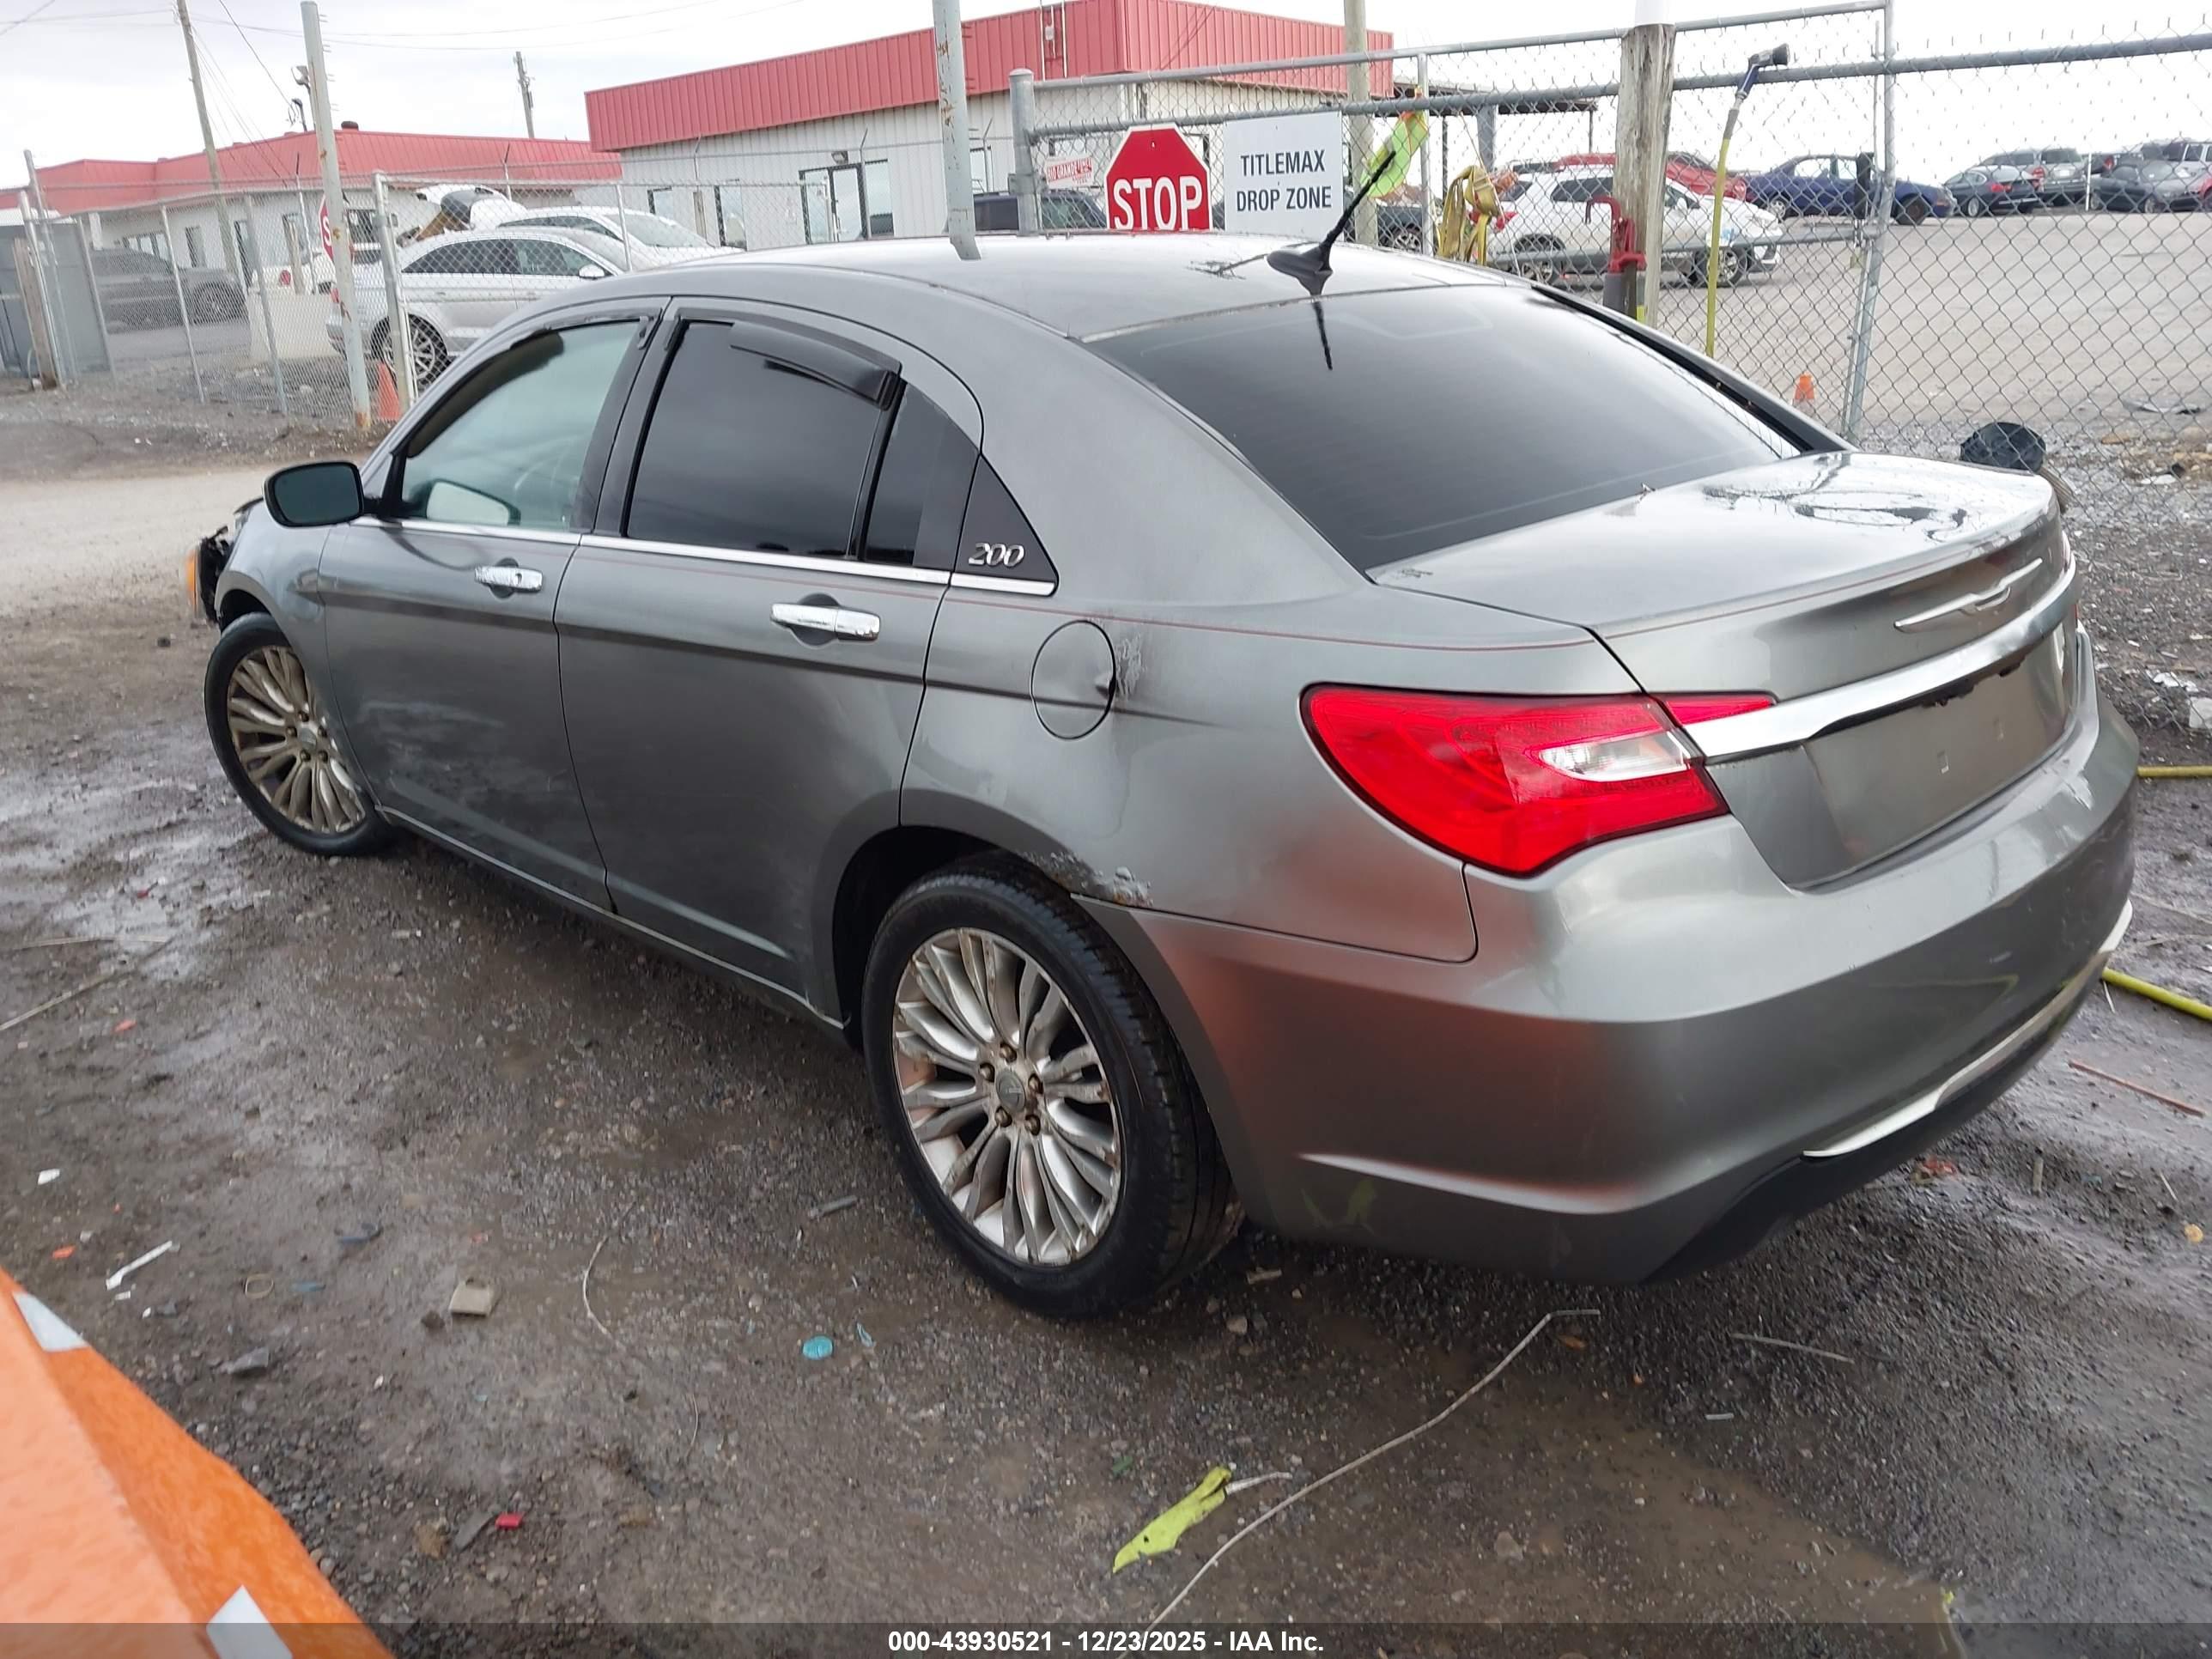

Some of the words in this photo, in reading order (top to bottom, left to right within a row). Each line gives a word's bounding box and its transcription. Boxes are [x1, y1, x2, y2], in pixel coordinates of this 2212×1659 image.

[1240, 149, 1326, 177] TITLEMAX
[1113, 175, 1203, 231] STOP
[1237, 189, 1280, 212] DROP
[1285, 185, 1332, 210] ZONE
[968, 542, 1025, 568] 200
